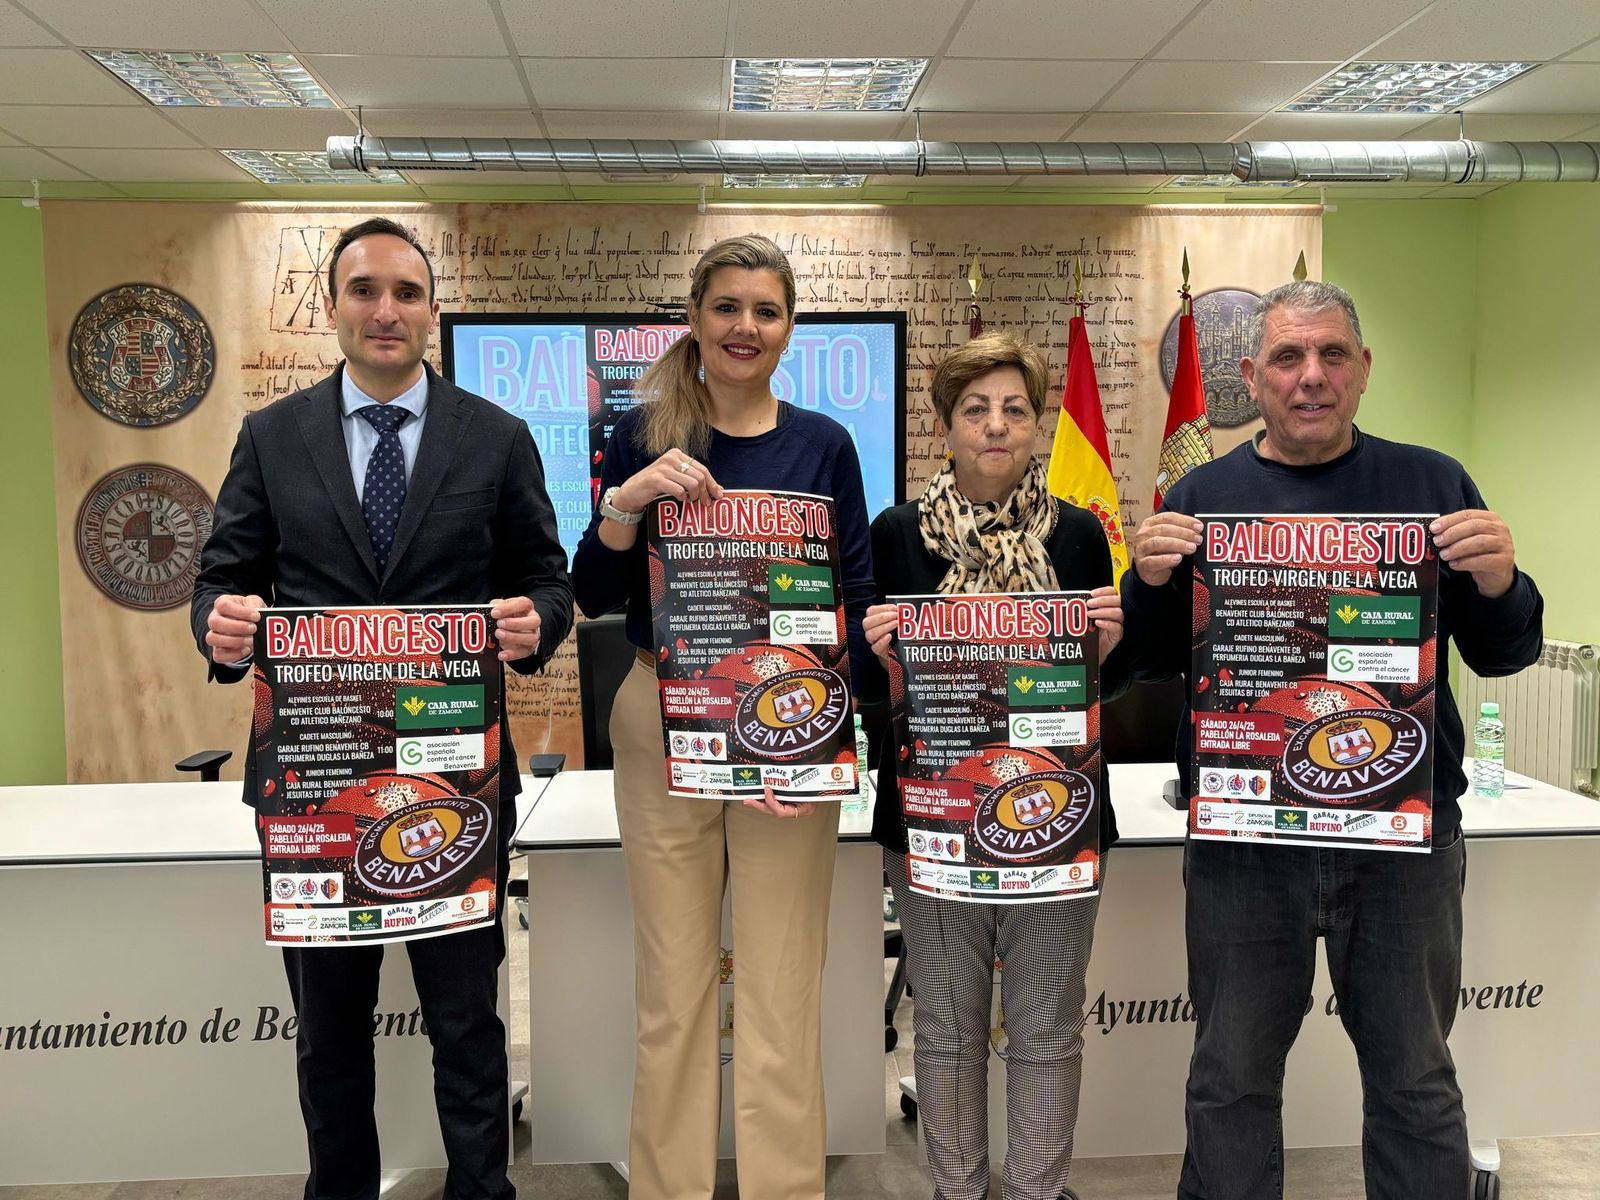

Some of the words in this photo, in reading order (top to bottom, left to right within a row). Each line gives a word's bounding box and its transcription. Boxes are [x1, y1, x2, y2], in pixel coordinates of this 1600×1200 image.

[657, 497, 829, 540] BALONCESTO
[1207, 522, 1425, 564] BALONCESTO
[665, 542, 715, 560] TROFEO
[718, 541, 765, 559] VIRGEN
[770, 542, 785, 558] DE
[788, 542, 802, 559] LA
[804, 543, 828, 561] VEGA
[1213, 569, 1268, 586] TROFEO
[1273, 570, 1326, 587] VIRGEN
[1333, 571, 1350, 588] DE
[1356, 571, 1373, 588] LA
[1379, 571, 1417, 589] VEGA
[753, 618, 767, 626] 11:00
[896, 598, 1089, 641] BALONCESTO
[1309, 616, 1327, 624] 10:00
[1360, 612, 1383, 620] CAJA
[1384, 612, 1414, 620] RURAL
[266, 612, 487, 658] BALONCESTO
[903, 645, 953, 662] TROFEO
[957, 644, 1005, 662] VIRGEN
[1009, 644, 1026, 661] DE
[1029, 643, 1046, 660] LA
[1049, 642, 1083, 660] VEGA
[1308, 651, 1325, 660] 11:00
[274, 664, 333, 683] TROFEO
[337, 662, 392, 682] VIRGEN
[398, 662, 416, 680] DE
[421, 661, 439, 679] LA
[443, 659, 481, 679] VEGA
[991, 687, 1007, 695] 10:00
[1036, 681, 1055, 689] CAJA
[1056, 680, 1082, 688] RURAL
[743, 686, 767, 714] EXCMO.
[767, 671, 832, 686] AYUNTAMIENTO
[427, 701, 449, 710] CAJA
[450, 700, 479, 709] RURAL
[376, 709, 394, 718] 10:00
[743, 685, 843, 746] BENAVENTE
[992, 720, 1007, 728] 11:00
[1200, 718, 1227, 729] SÁBADO
[1228, 721, 1255, 731] 26/4/25
[1200, 728, 1234, 740] PABELLÓN
[1235, 731, 1244, 740] LA
[1246, 732, 1280, 742] ROSALEDA
[1293, 724, 1321, 752] EXCMO.
[1322, 710, 1401, 724] AYUNTAMIENTO
[426, 740, 460, 749] asociación
[1051, 737, 1081, 745] Benavente
[1200, 740, 1231, 749] ENTRADA
[1232, 741, 1251, 750] LIBRE
[376, 745, 394, 755] 11:00
[426, 748, 456, 756] española
[444, 761, 477, 770] Benavente
[1292, 729, 1417, 789] BENAVENTE
[904, 784, 925, 795] SÁBADO
[925, 788, 949, 797] 26/4/25
[982, 788, 1006, 817] EXCMO.
[1007, 773, 1075, 789] AYUNTAMIENTO
[905, 793, 931, 805] PABELLÓN
[931, 798, 940, 806] LA
[940, 798, 971, 807] ROSALEDA
[906, 803, 929, 814] ENTRADA
[929, 806, 946, 815] LIBRE
[982, 786, 1088, 848] BENAVENTE
[268, 822, 297, 834] SÁBADO
[297, 823, 325, 834] 26/4/25
[365, 819, 392, 851] EXCMO.
[393, 800, 470, 820] AYUNTAMIENTO
[269, 832, 304, 845] PABELLÓN
[304, 834, 314, 844] LA
[315, 832, 352, 844] ROSALEDA
[269, 844, 301, 854] ENTRADA
[301, 844, 322, 854] LIBRE
[364, 812, 484, 882] BENAVENTE
[1460, 979, 1544, 1010] vente
[1084, 990, 1198, 1034] Ayunta
[0, 1011, 187, 1050] ntamiento
[200, 1007, 240, 1044] de
